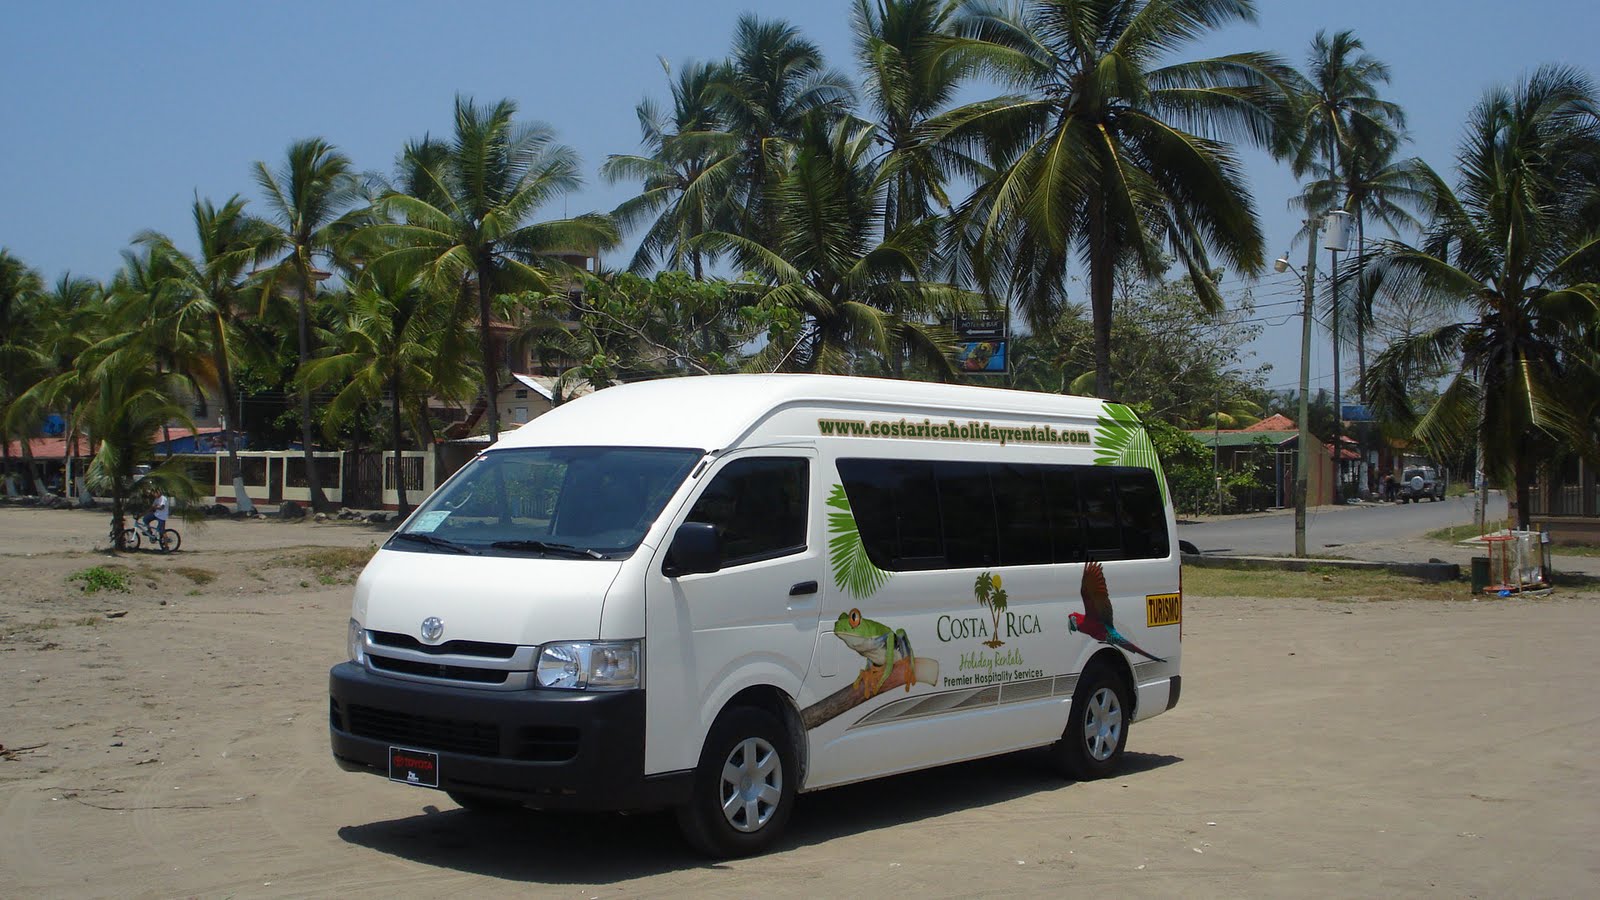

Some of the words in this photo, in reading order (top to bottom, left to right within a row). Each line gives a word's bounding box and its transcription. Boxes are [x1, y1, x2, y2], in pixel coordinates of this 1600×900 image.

[819, 419, 1090, 445] www.costaricaholidayrentals.com
[1149, 597, 1178, 623] TURISMO
[937, 615, 987, 642] COSTA
[1006, 612, 1041, 637] RICA
[959, 651, 992, 674] Holiday
[995, 648, 1024, 667] Rentals
[944, 675, 972, 687] Premier
[974, 671, 1012, 684] Hospitality
[1014, 669, 1043, 680] Services
[405, 757, 433, 769] TOYOTA
